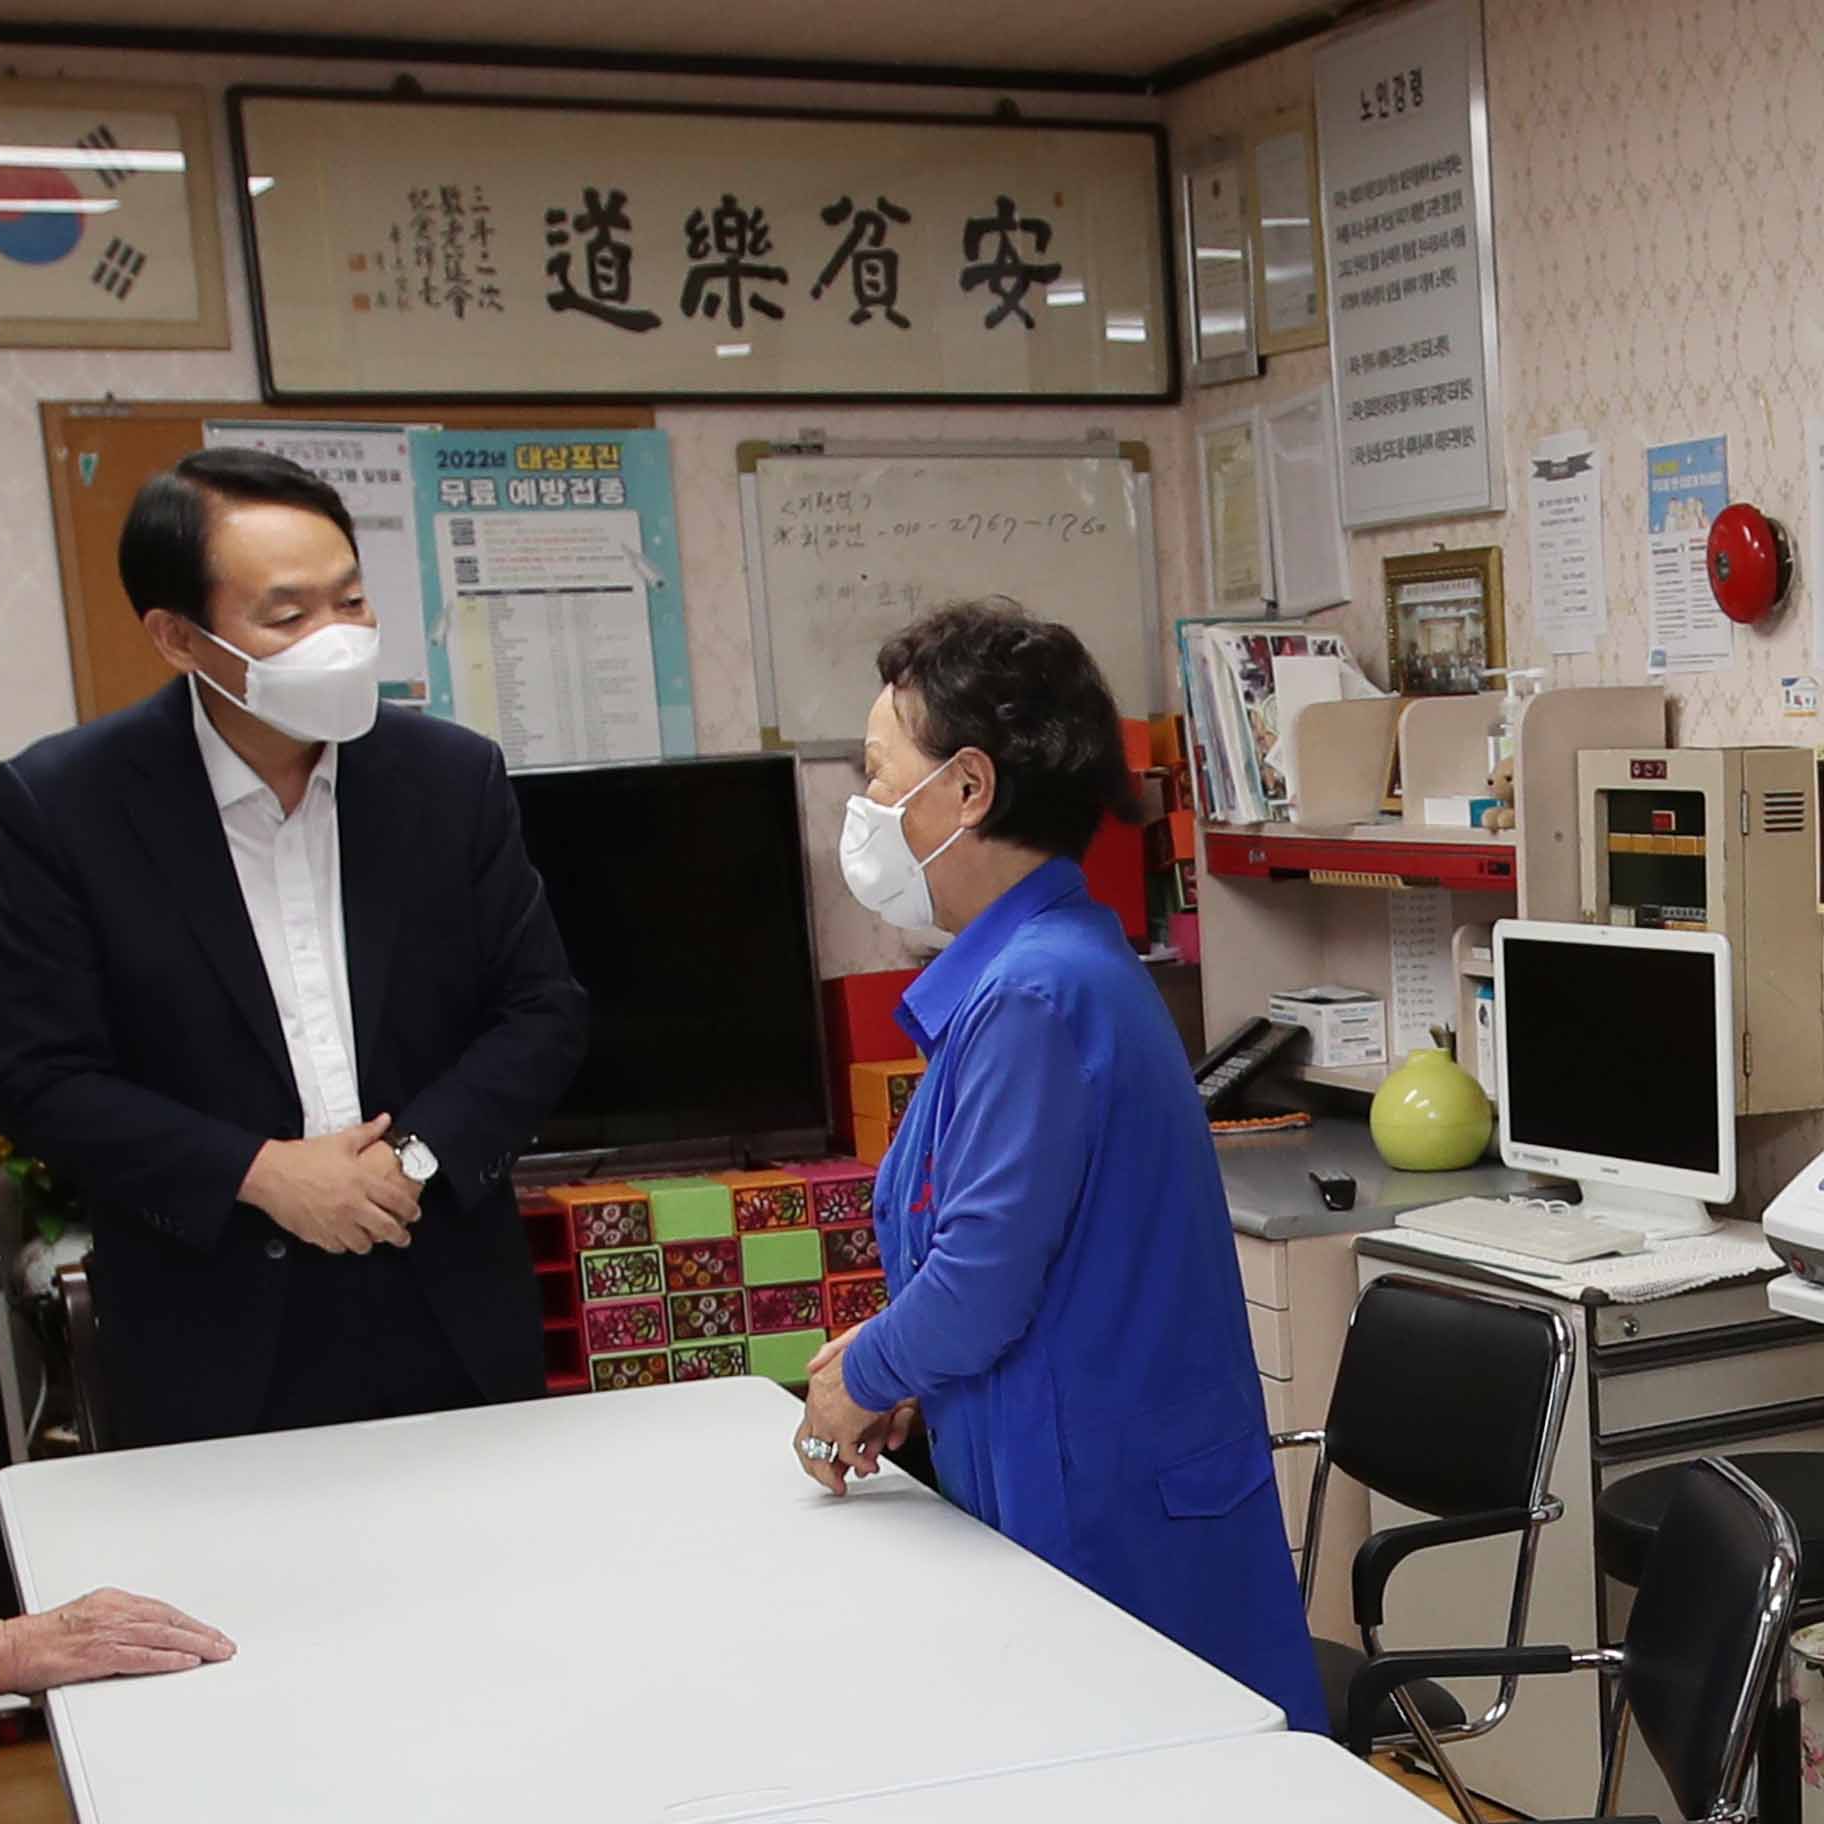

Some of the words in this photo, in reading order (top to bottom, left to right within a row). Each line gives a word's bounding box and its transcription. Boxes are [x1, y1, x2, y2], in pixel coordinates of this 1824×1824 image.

[1360, 66, 1424, 120] 노인강령
[437, 449, 506, 469] 2022년
[516, 443, 622, 471] 대상포진
[440, 477, 498, 507] 무료
[508, 477, 625, 507] 예방접종
